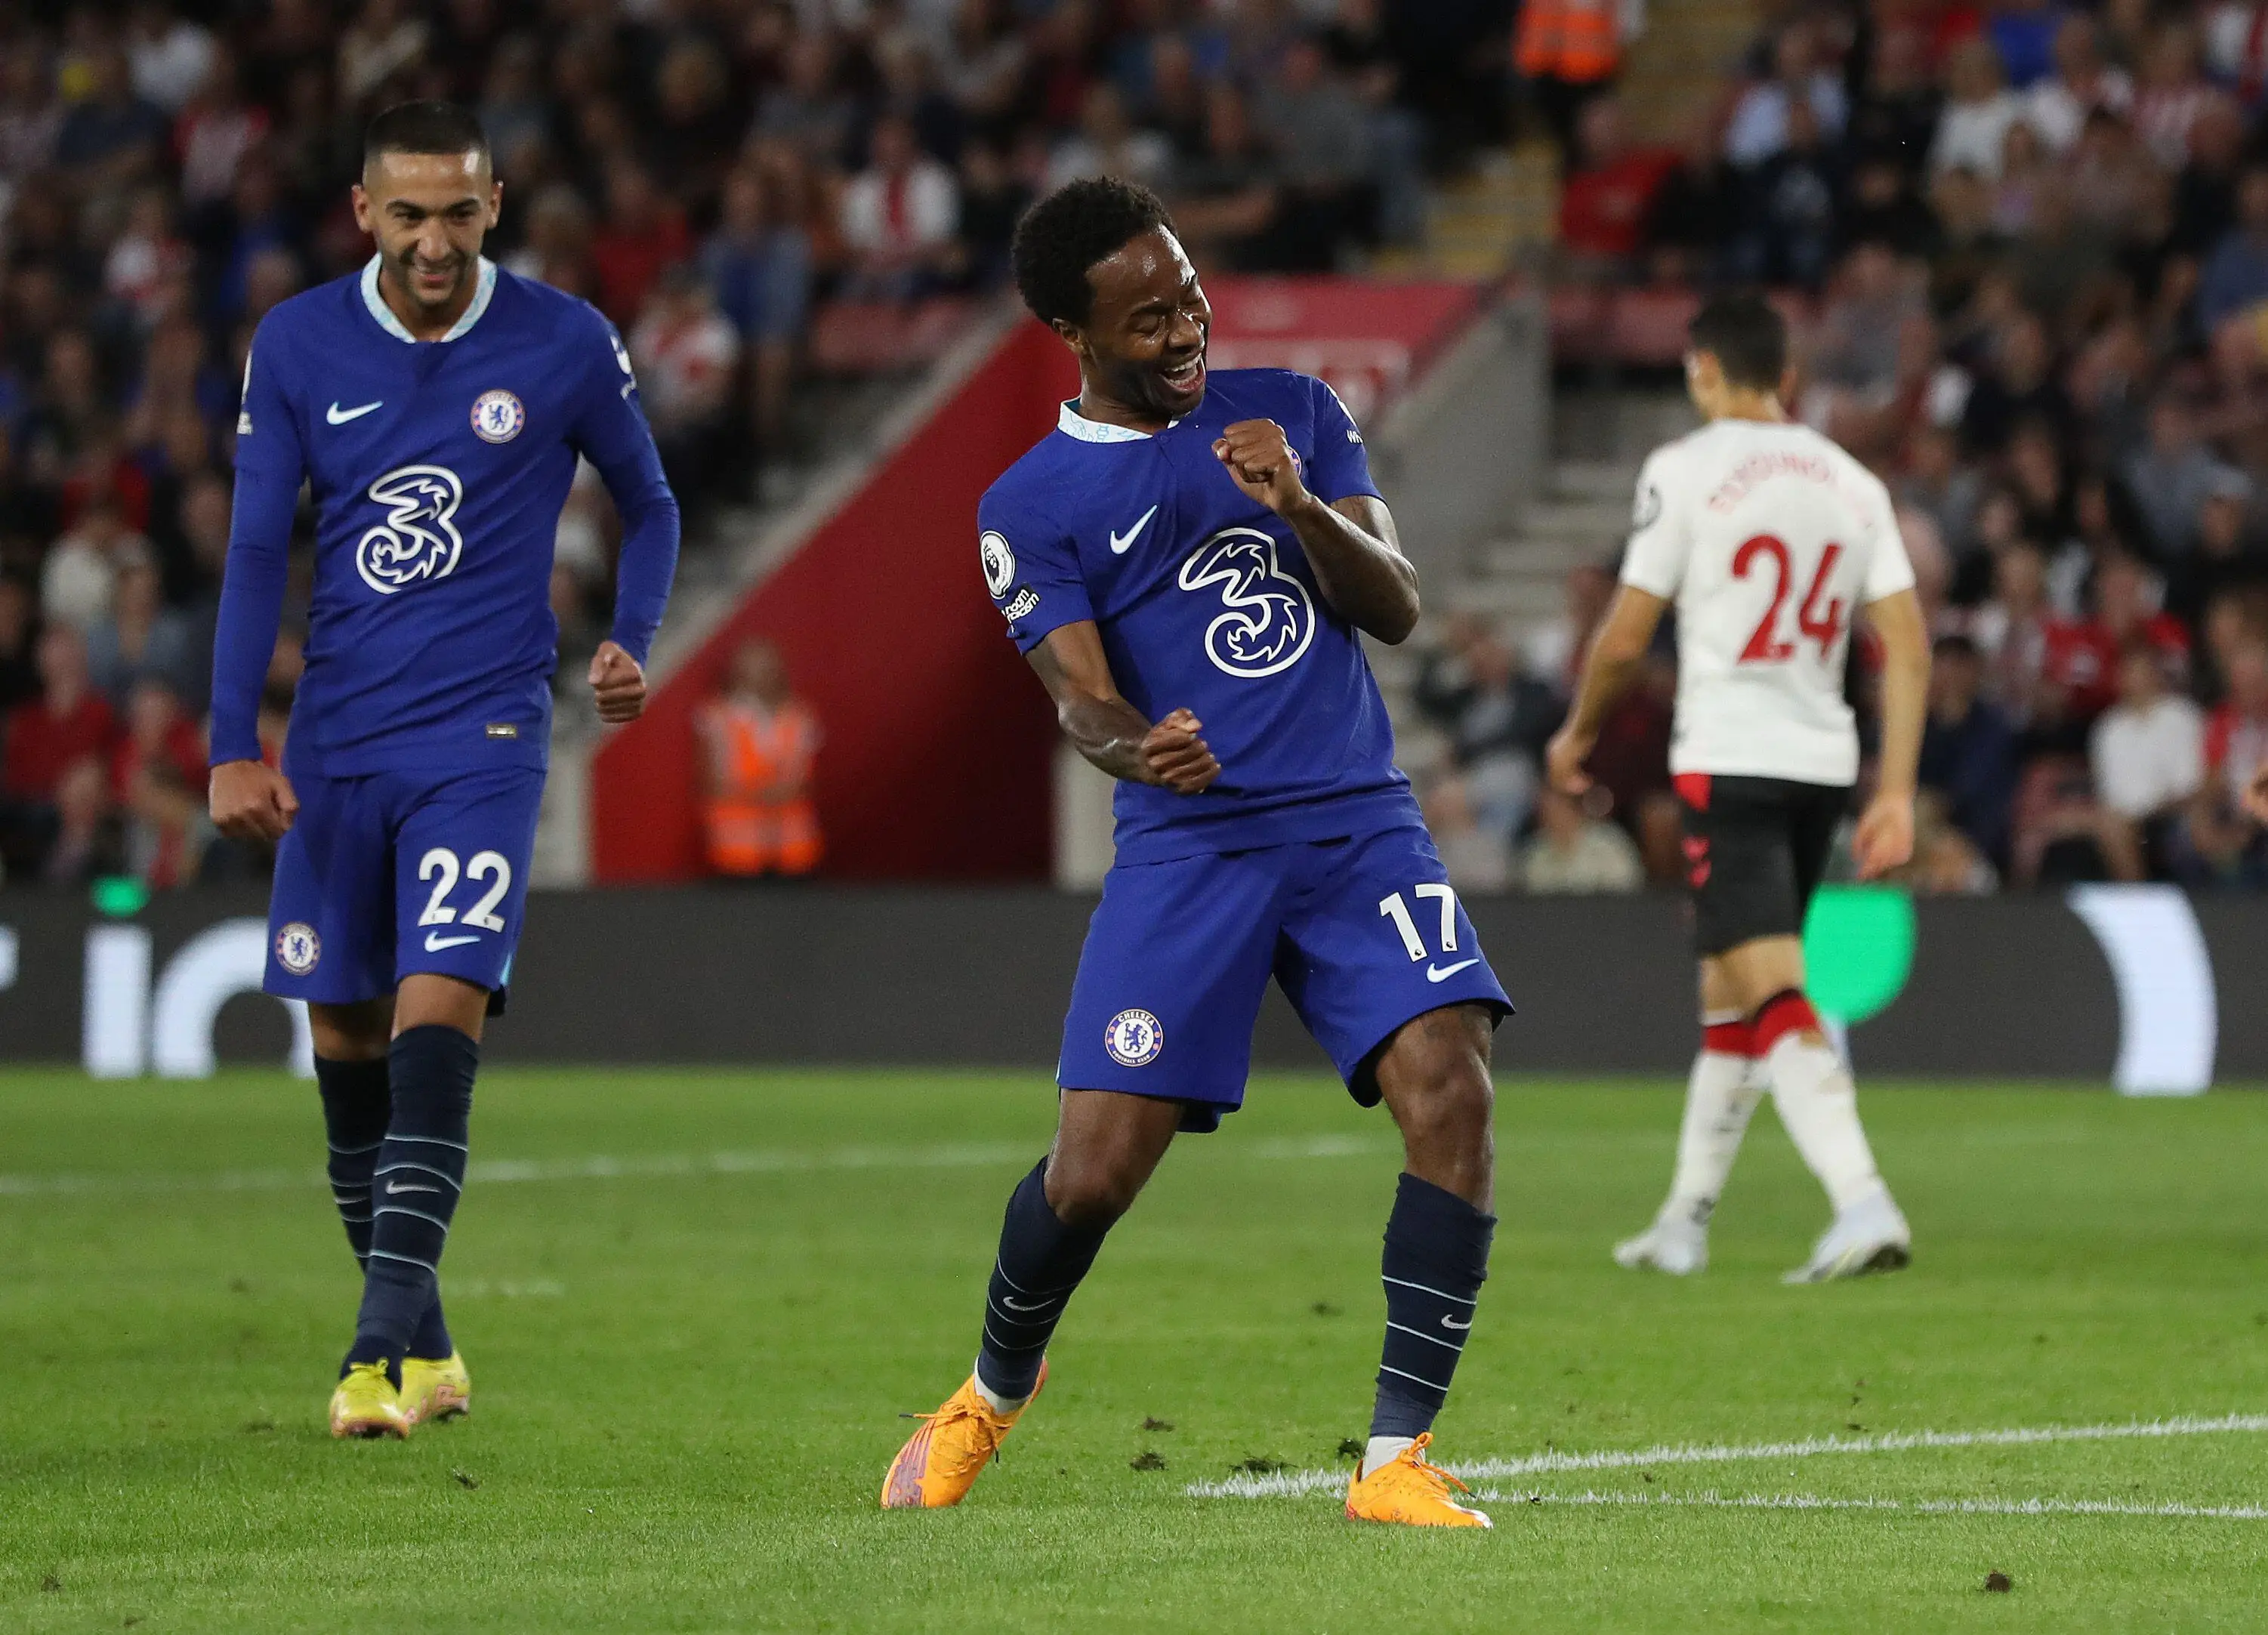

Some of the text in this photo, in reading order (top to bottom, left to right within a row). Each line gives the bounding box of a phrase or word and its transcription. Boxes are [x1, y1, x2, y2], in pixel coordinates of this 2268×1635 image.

[1005, 589, 1029, 615] room
[1732, 533, 1844, 665] 24
[418, 847, 511, 933] 22
[1378, 883, 1458, 963] 17
[1118, 1011, 1155, 1026] CHELSEA
